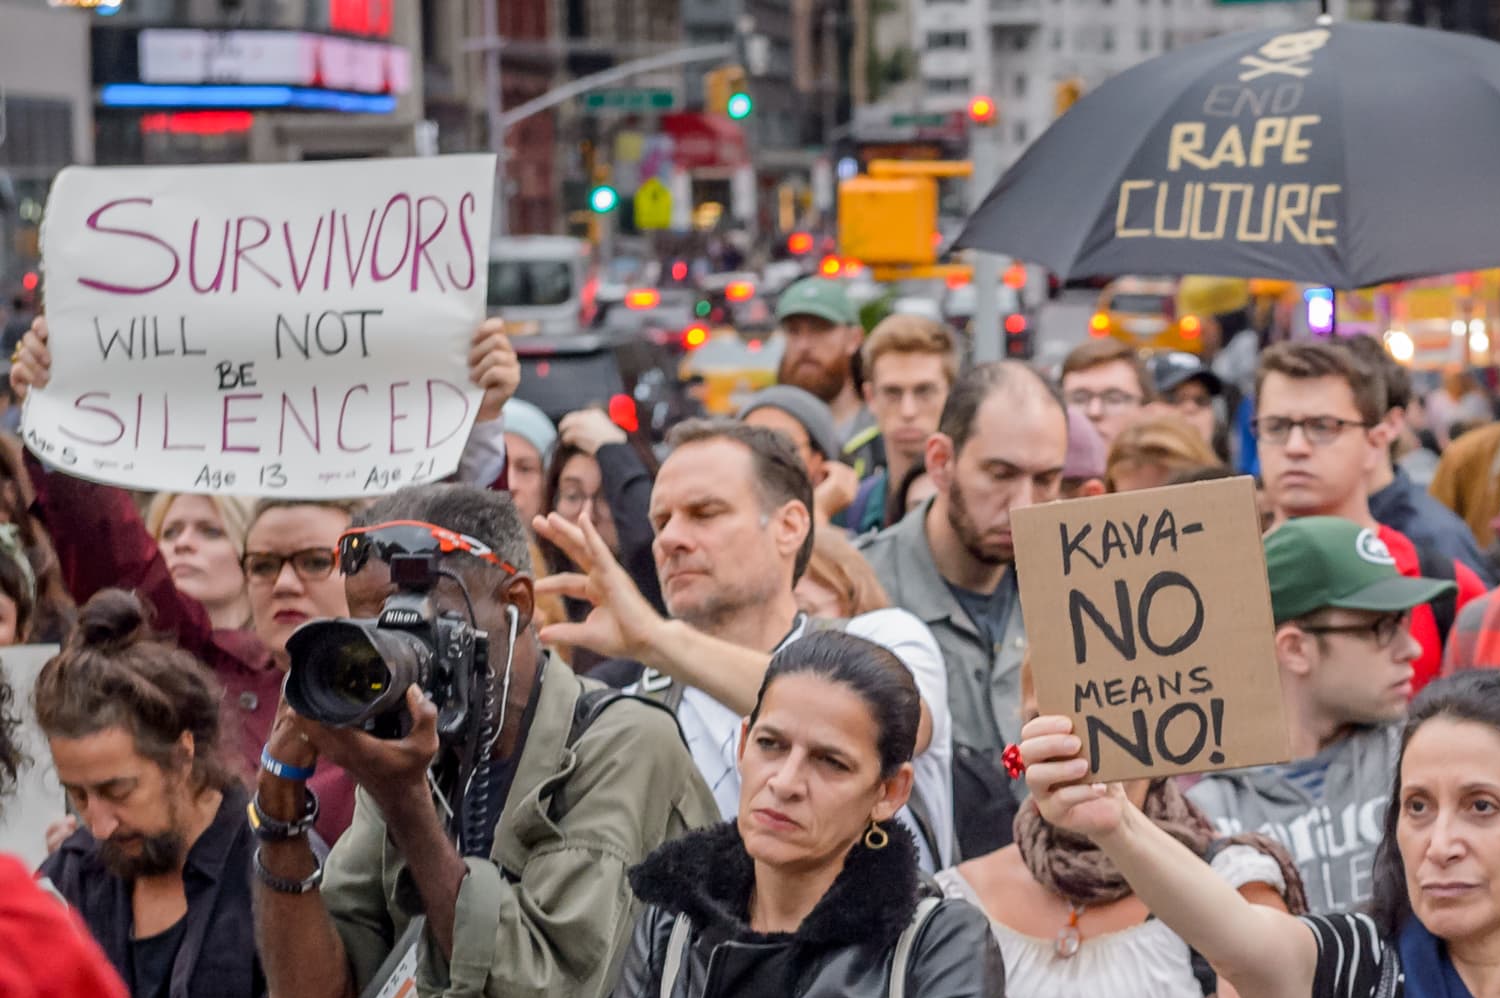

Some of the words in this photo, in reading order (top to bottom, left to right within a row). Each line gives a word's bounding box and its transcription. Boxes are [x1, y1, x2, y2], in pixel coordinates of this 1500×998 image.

[1203, 81, 1303, 117] END
[1167, 115, 1321, 171] RAPE
[1115, 179, 1342, 245] CULTURE
[77, 192, 476, 296] SURVIVORS
[94, 315, 206, 361] WILL
[275, 308, 383, 360] NOT
[215, 360, 257, 391] BE
[58, 378, 470, 455] SILENCED
[194, 463, 237, 489] Age
[259, 462, 288, 488] 13
[363, 465, 402, 490] Age
[1060, 508, 1205, 576] KAVA-
[385, 610, 419, 623] Nikon
[1069, 570, 1205, 665] NO
[1074, 666, 1214, 712] MEANS
[1086, 698, 1226, 774] NO!
